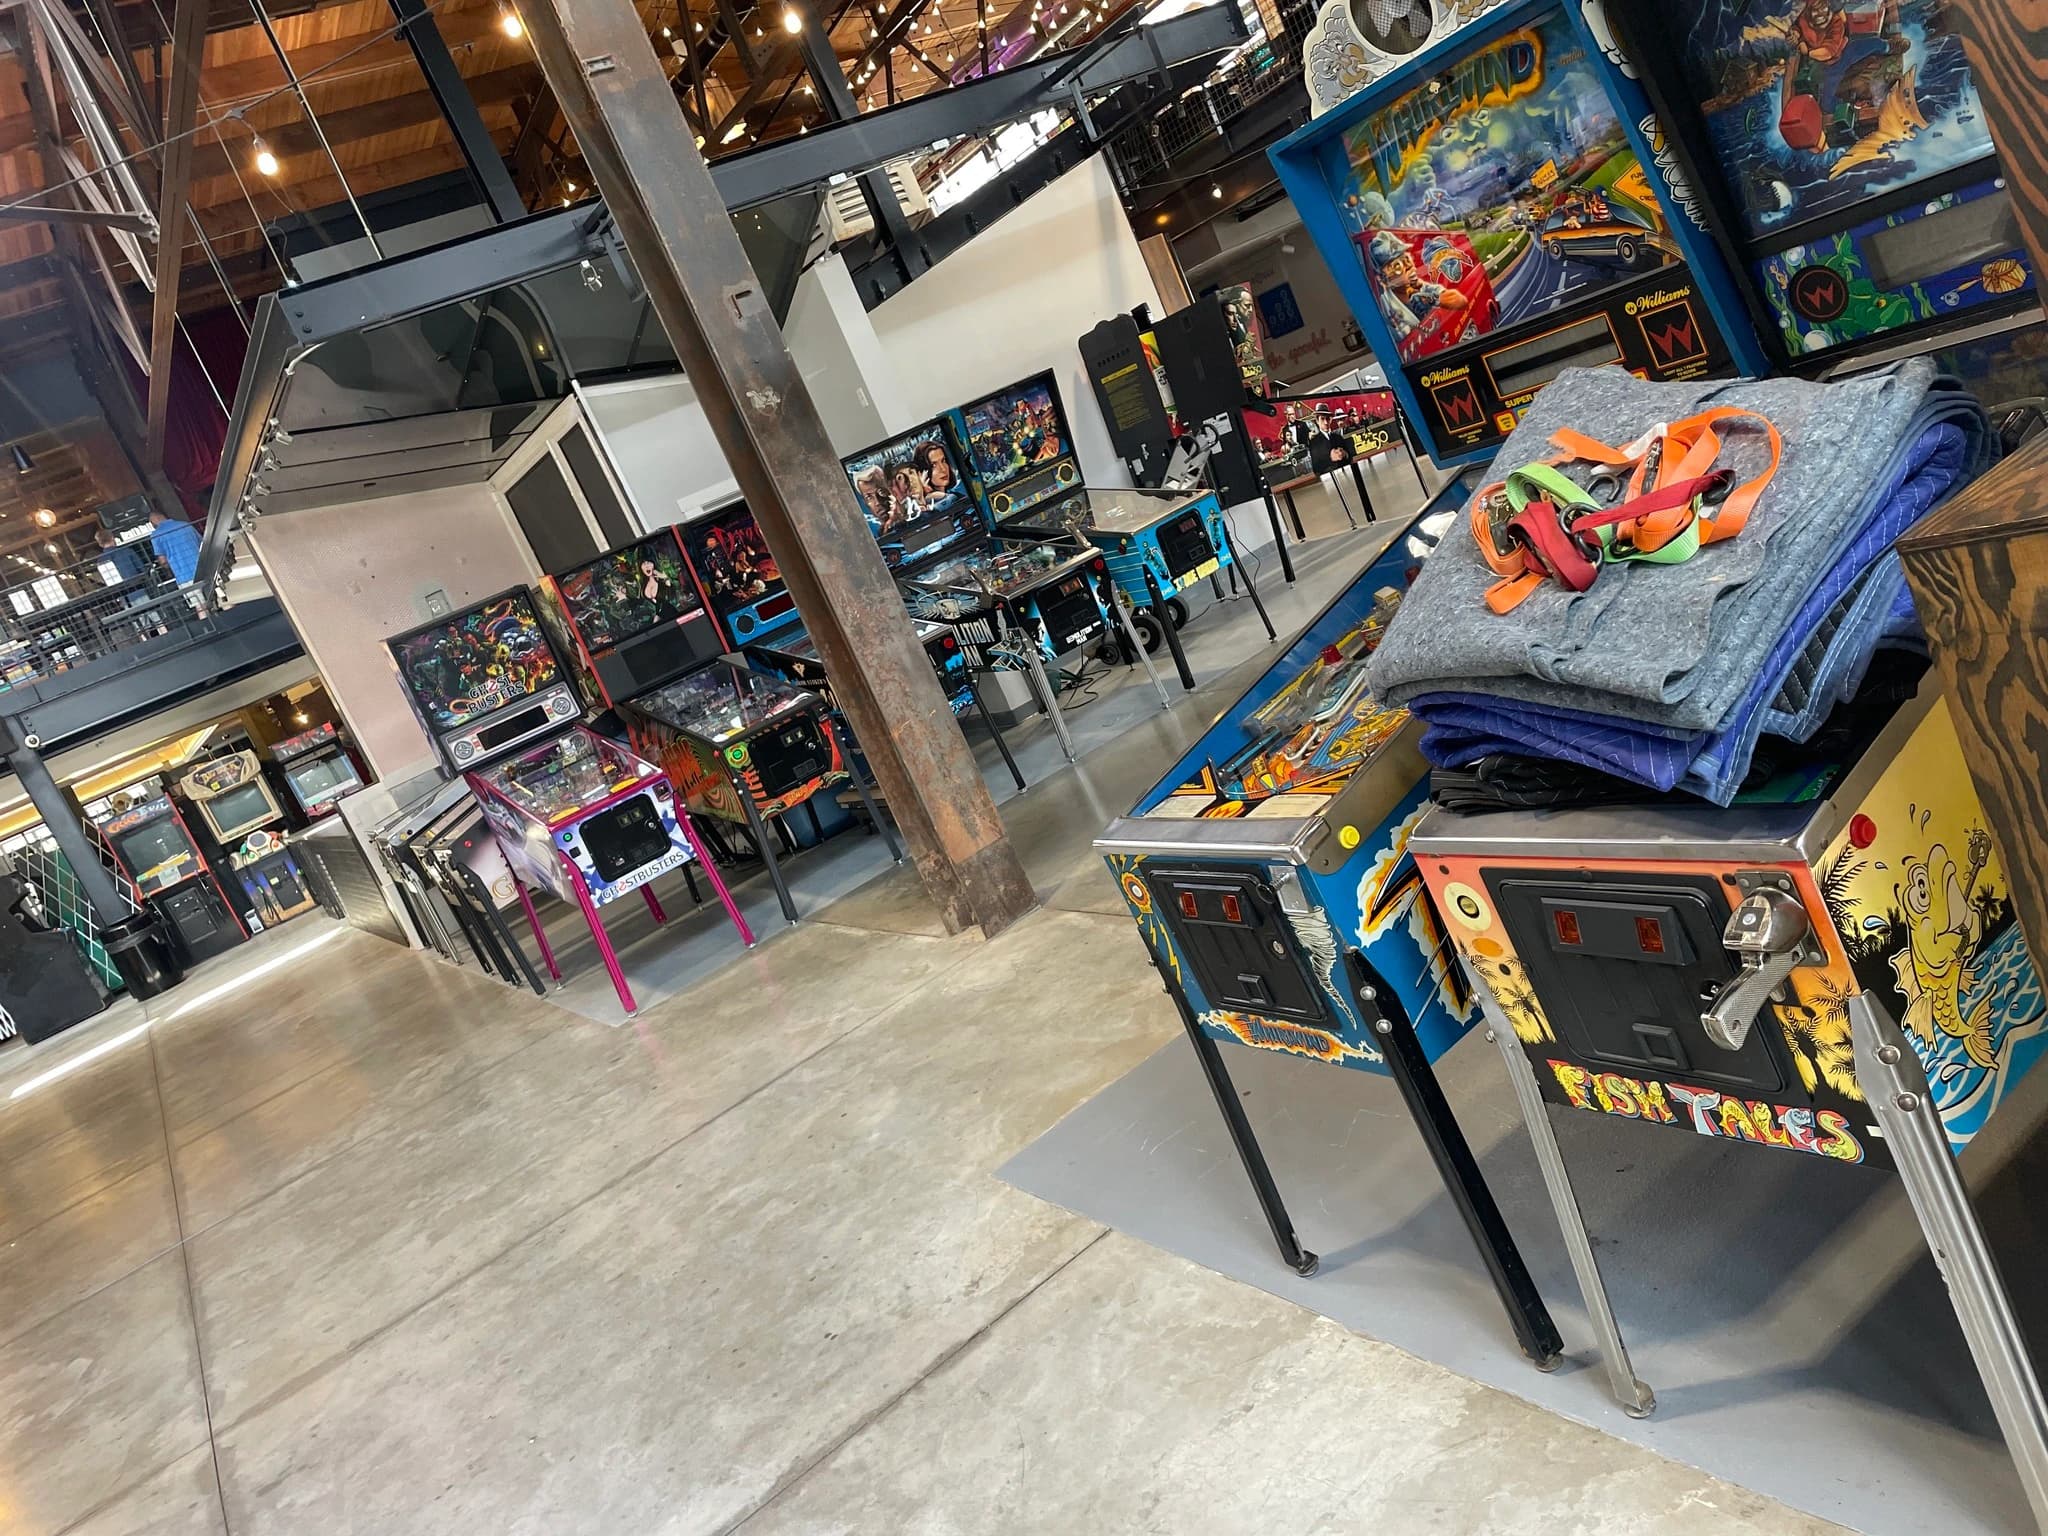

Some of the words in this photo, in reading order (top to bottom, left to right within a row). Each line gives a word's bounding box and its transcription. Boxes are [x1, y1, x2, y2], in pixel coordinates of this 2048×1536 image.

[1350, 40, 1537, 197] WHIRLWIND
[1635, 287, 1690, 311] Williams
[1429, 365, 1470, 386] Williams
[1505, 395, 1532, 408] SUPER
[467, 681, 526, 714] BUSTERS
[602, 850, 685, 900] GHOSTBUSTERS
[1546, 1058, 1679, 1125] FISH
[1665, 1082, 1866, 1165] TALES
